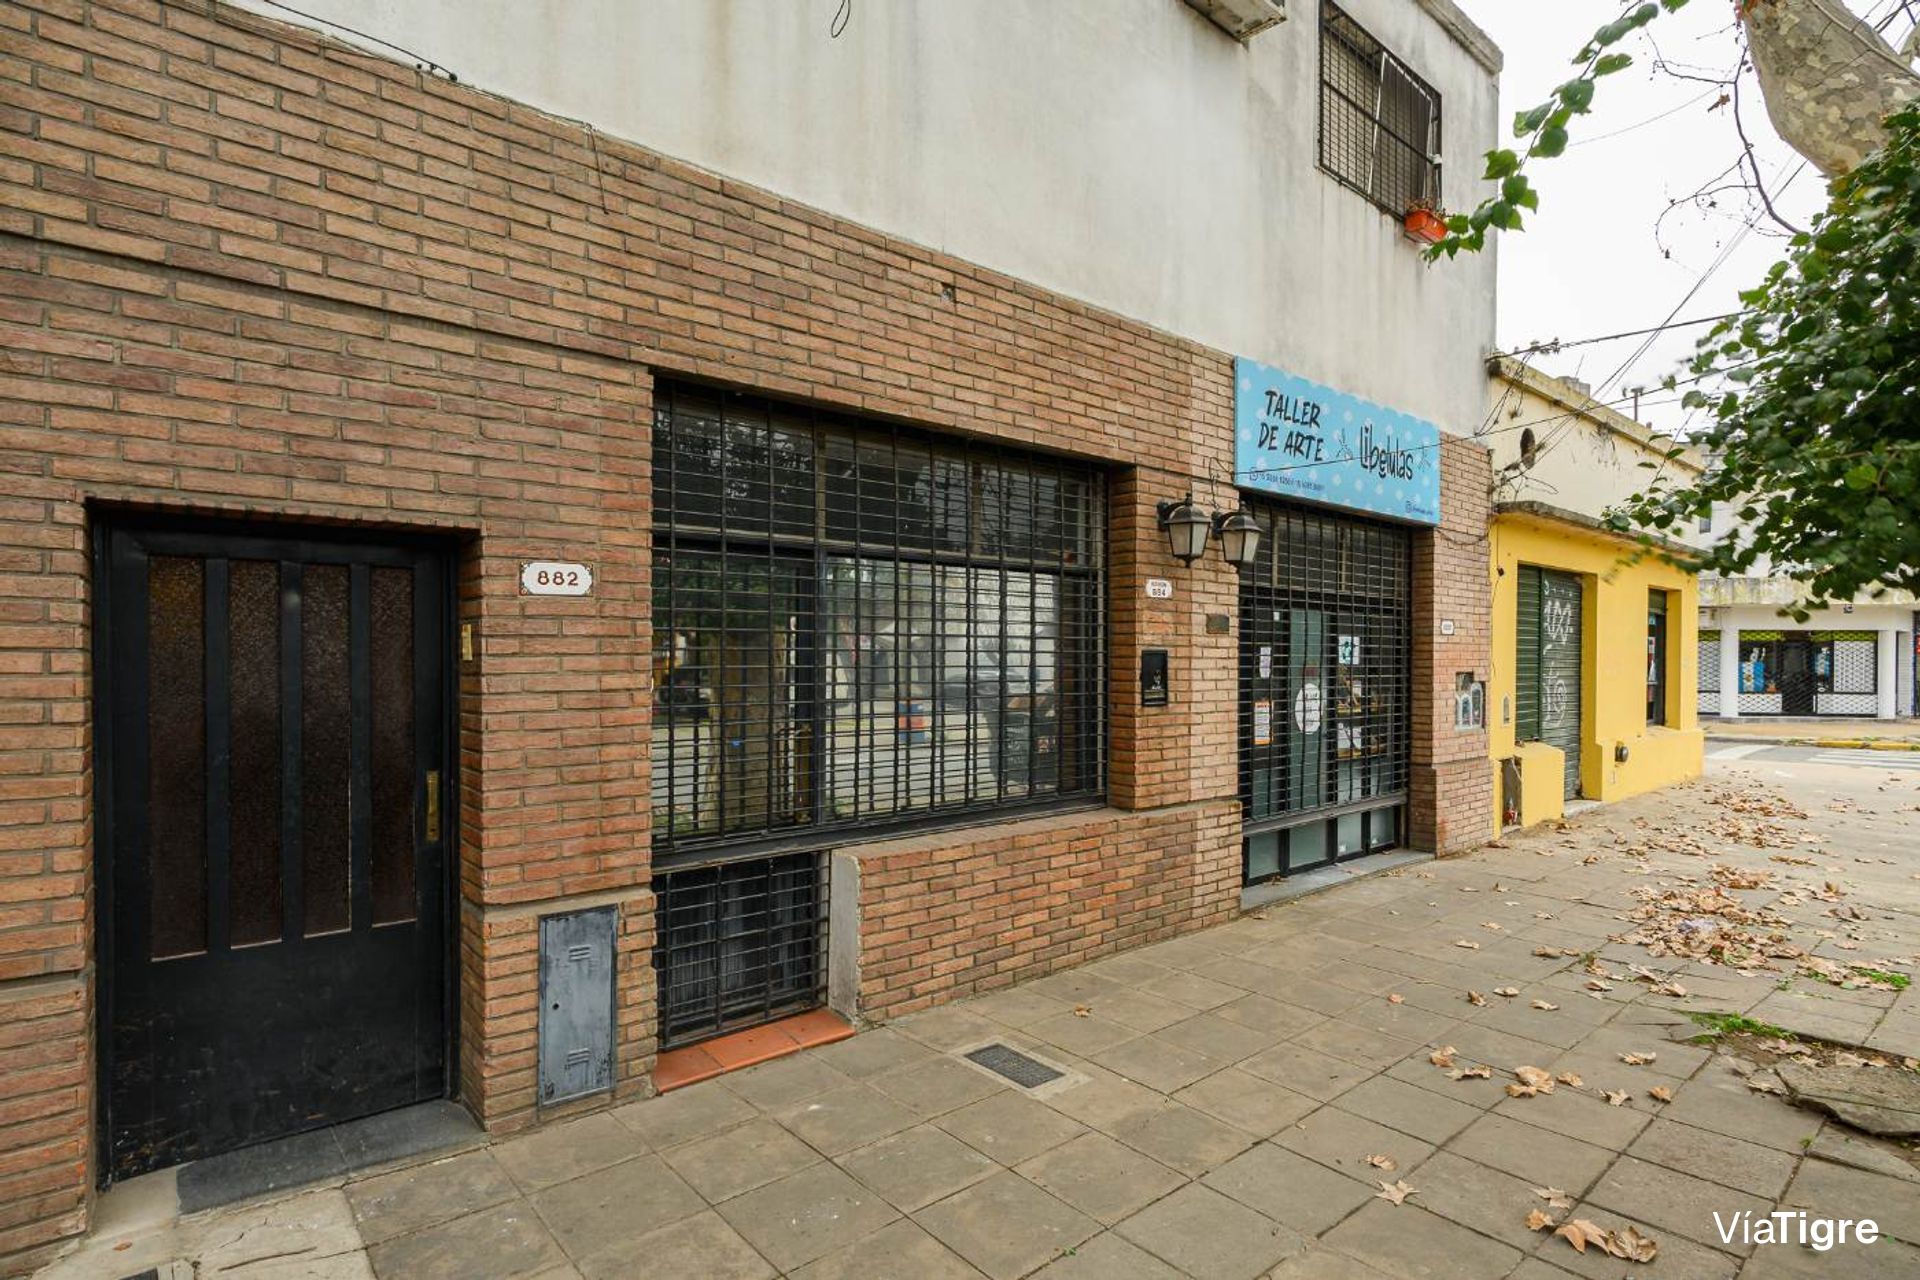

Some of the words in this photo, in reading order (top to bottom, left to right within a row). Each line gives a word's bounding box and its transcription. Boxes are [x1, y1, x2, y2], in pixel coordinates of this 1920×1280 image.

[1265, 390, 1321, 429] TALLER
[1258, 422, 1278, 451] DE
[1284, 432, 1325, 462] ARTE
[537, 570, 579, 586] 882
